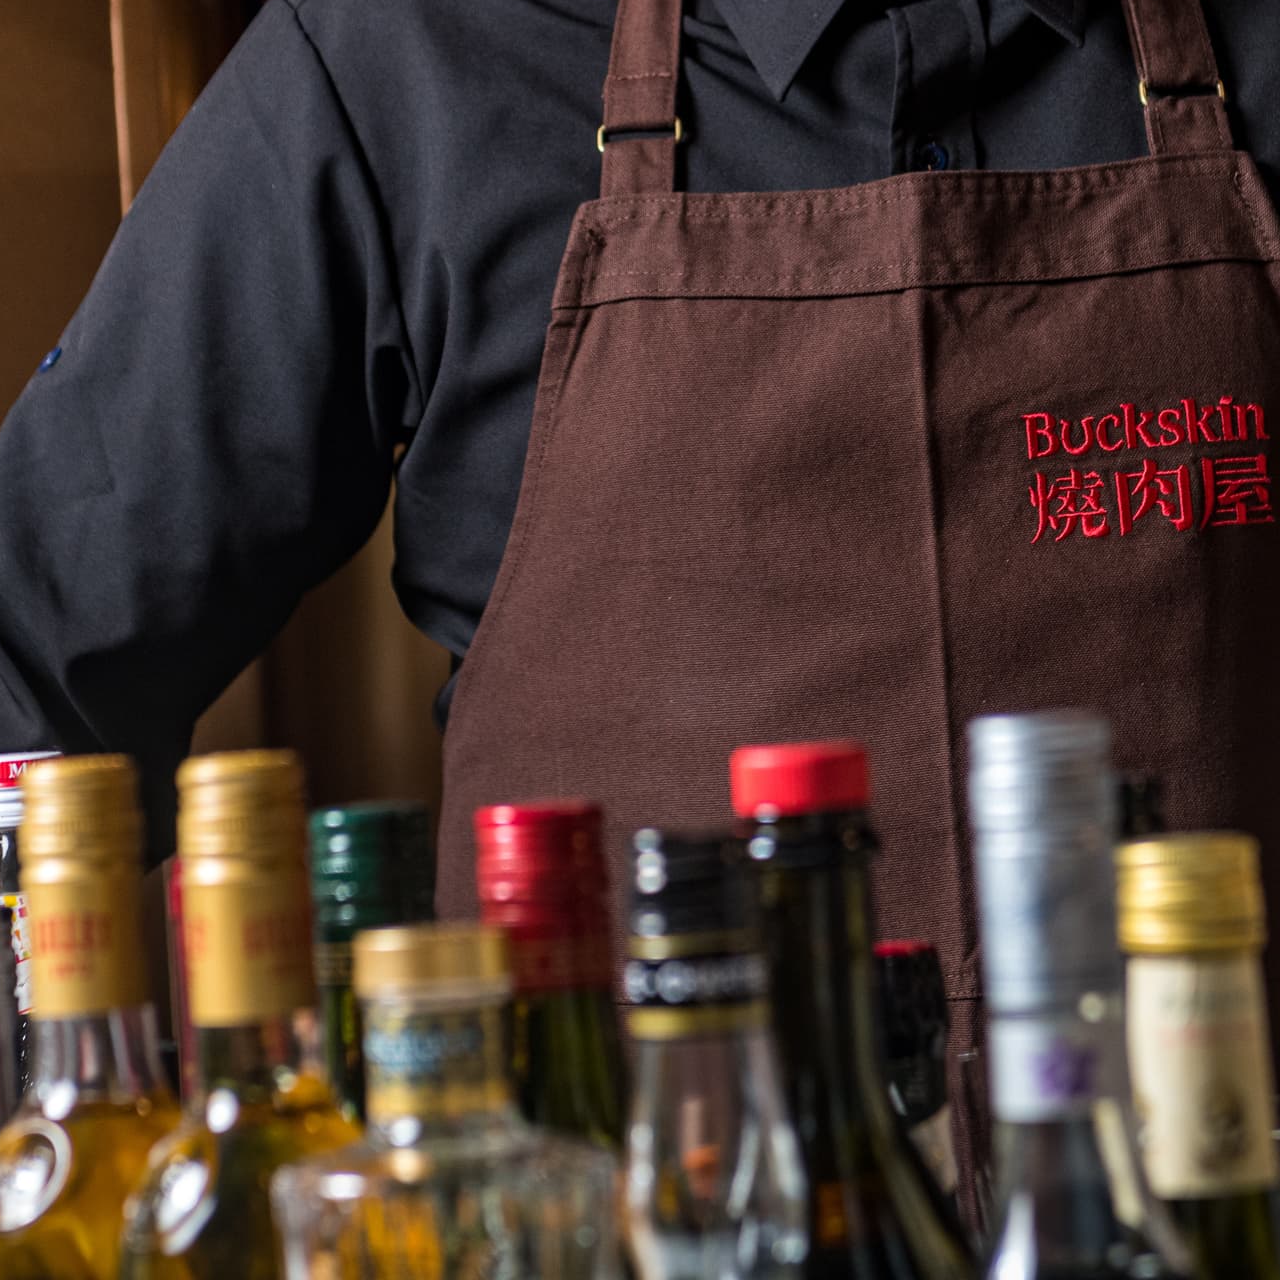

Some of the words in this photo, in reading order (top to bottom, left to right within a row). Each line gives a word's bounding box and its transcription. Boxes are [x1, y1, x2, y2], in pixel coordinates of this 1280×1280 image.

[1023, 395, 1270, 460] Buckskin
[1028, 453, 1274, 544] 燒肉屋
